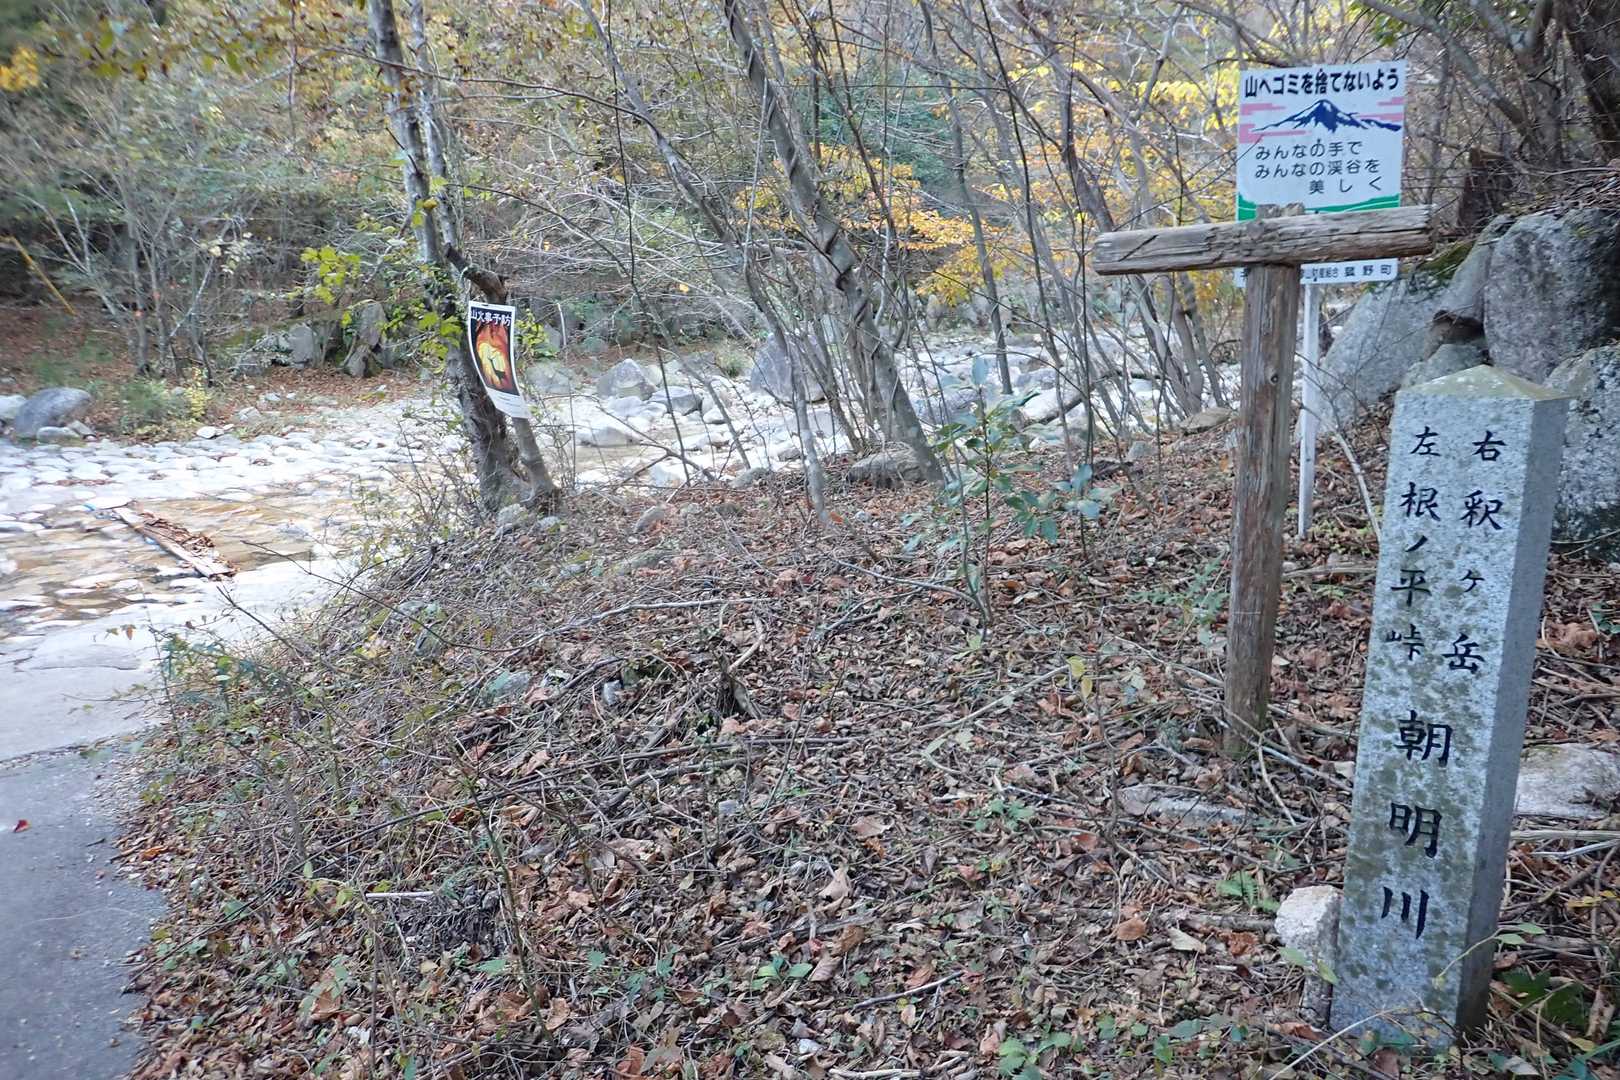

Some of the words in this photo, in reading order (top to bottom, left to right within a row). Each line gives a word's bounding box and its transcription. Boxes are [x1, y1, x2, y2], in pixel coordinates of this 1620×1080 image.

[1244, 69, 1400, 98] 山へゴミを捨てないよう
[1255, 140, 1363, 160] みんなの手で
[1254, 159, 1382, 179] みんなの渓谷を
[1308, 175, 1383, 195] 美しく
[470, 308, 512, 327] 山火事予防
[1381, 709, 1454, 940] 朝明川
